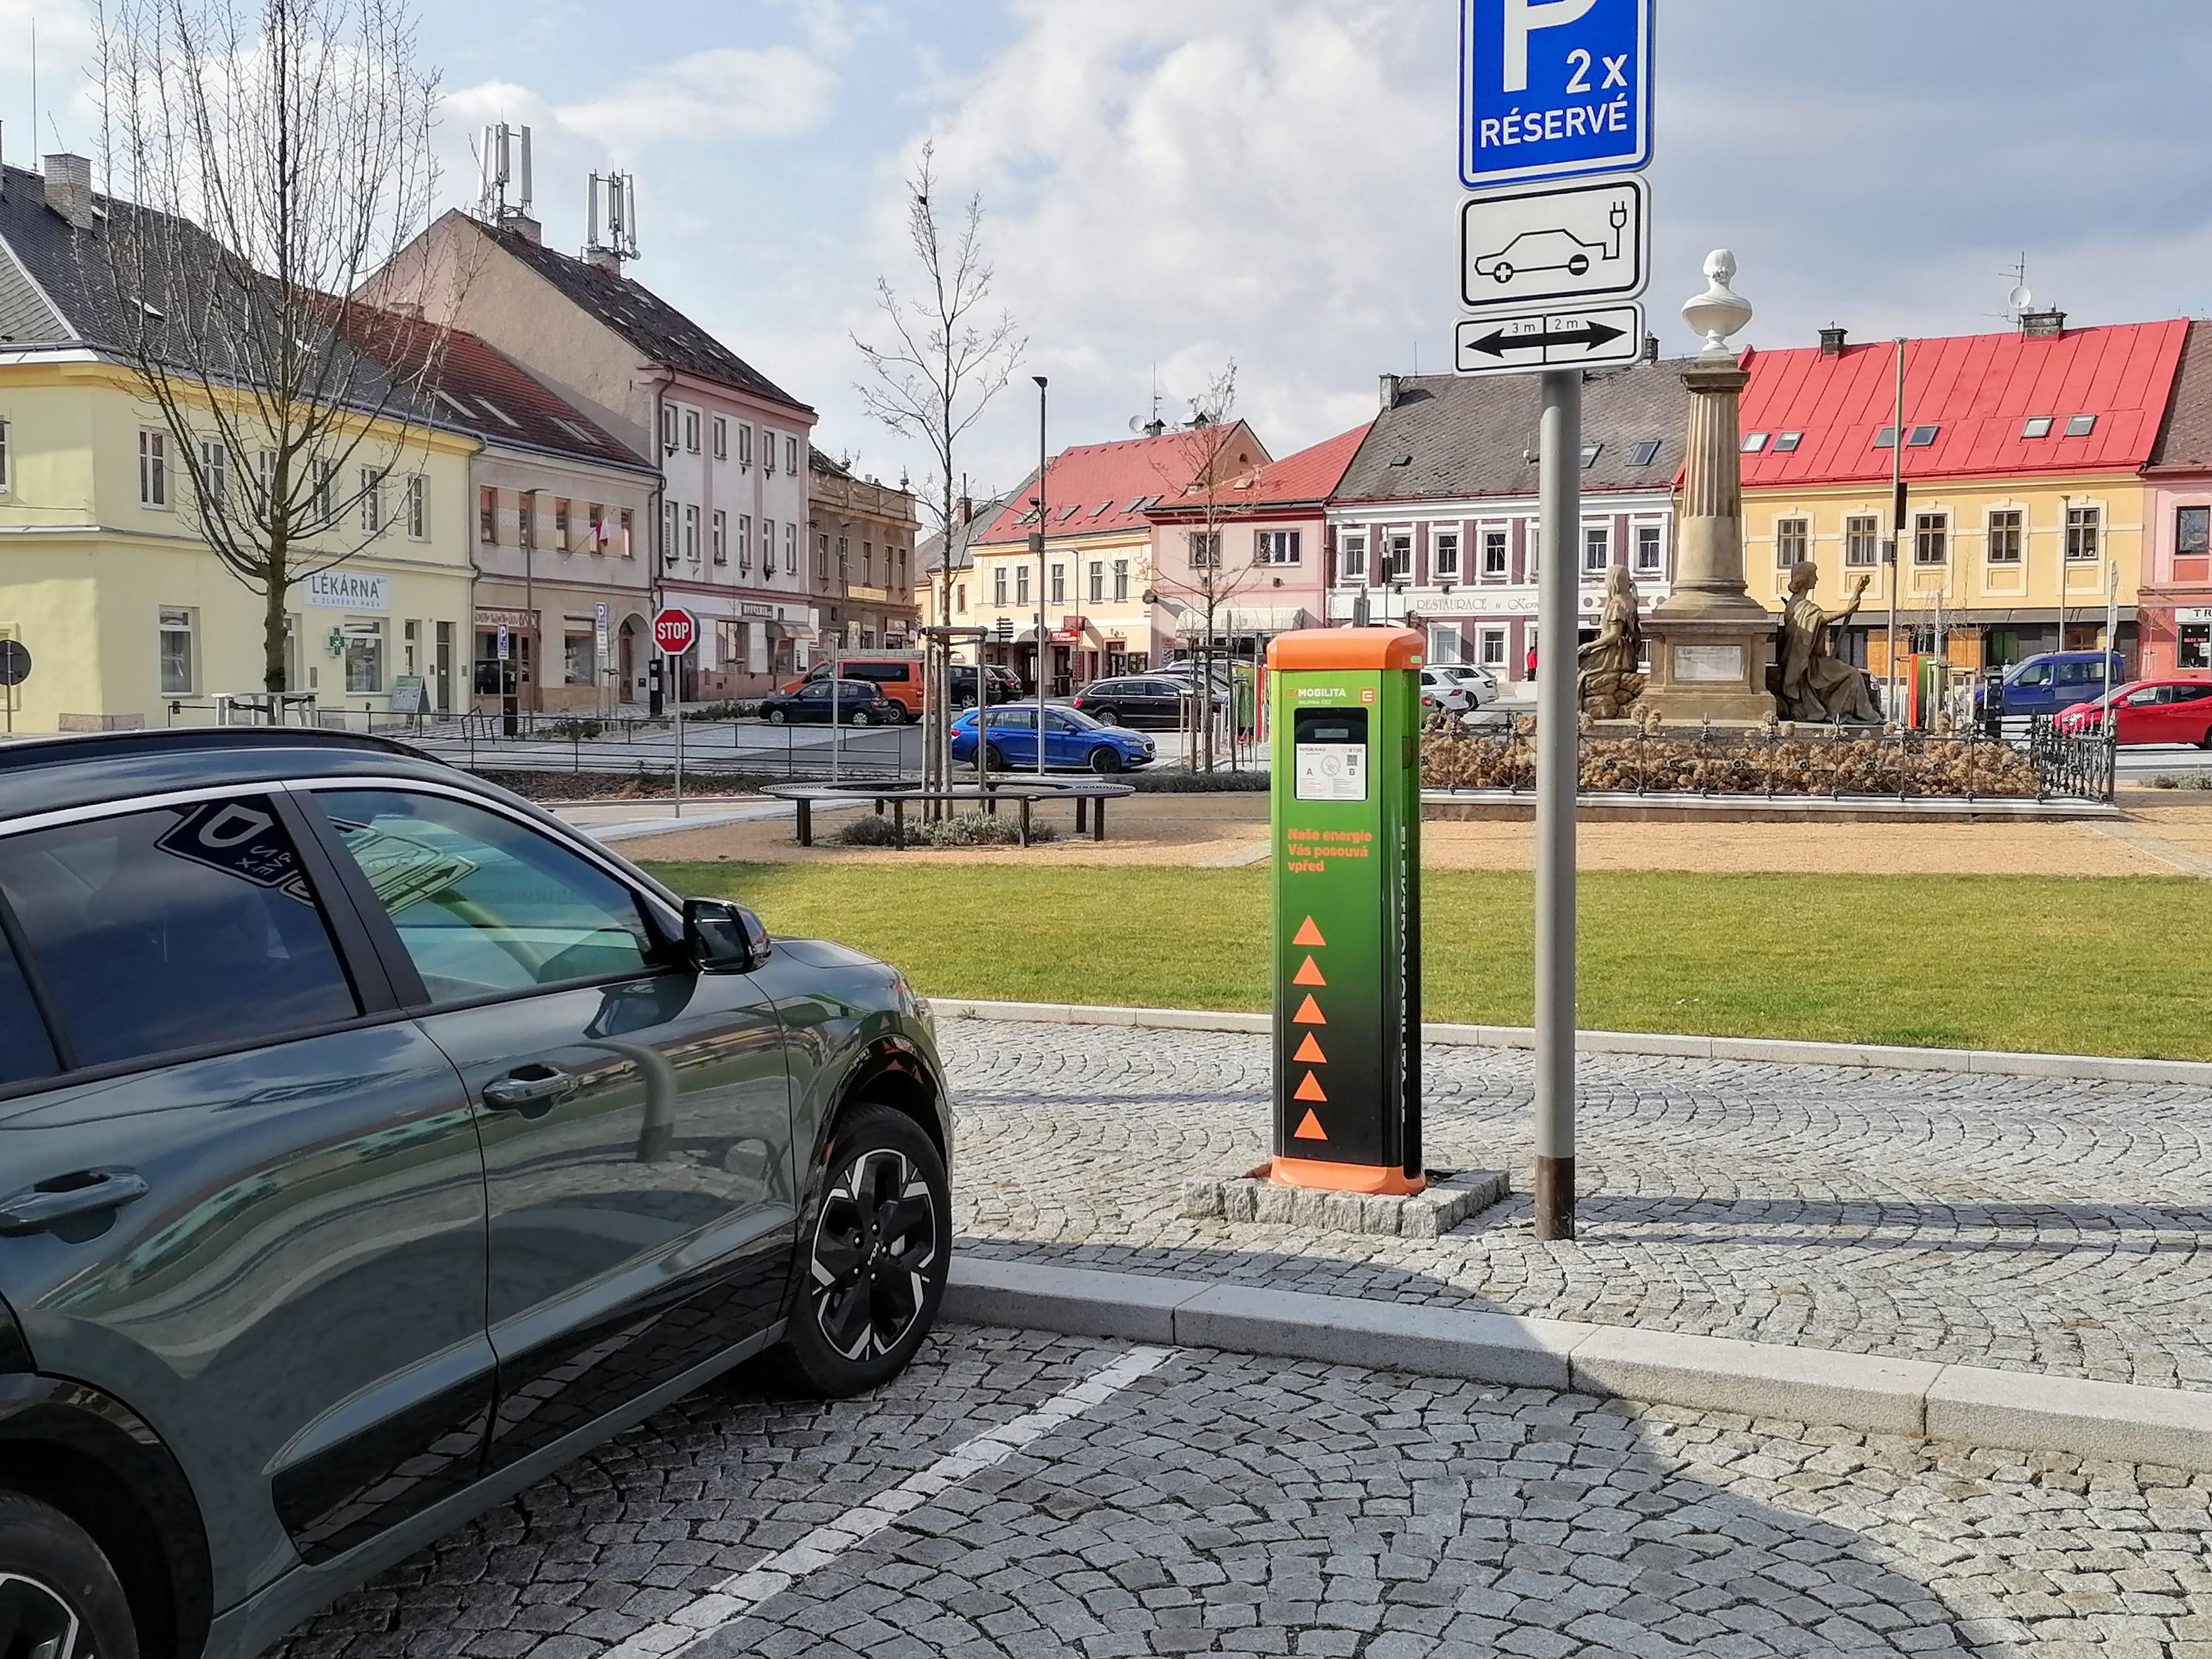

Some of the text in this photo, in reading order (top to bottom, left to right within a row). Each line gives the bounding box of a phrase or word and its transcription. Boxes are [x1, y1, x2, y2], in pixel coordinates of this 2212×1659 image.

[1503, 0, 1595, 93] P
[1566, 48, 1628, 94] 2 x
[1481, 93, 1628, 148] RÉSERVÉ
[1512, 322, 1535, 334] 3 m
[1554, 319, 1578, 330] 2 m
[312, 571, 379, 599] LÉKÁRNA
[1416, 597, 1487, 611] RESTAURACE
[658, 622, 689, 640] STOP
[1287, 828, 1372, 843] Naše energie
[1287, 843, 1368, 858] Vás posouvá
[1287, 859, 1324, 873] vpřed
